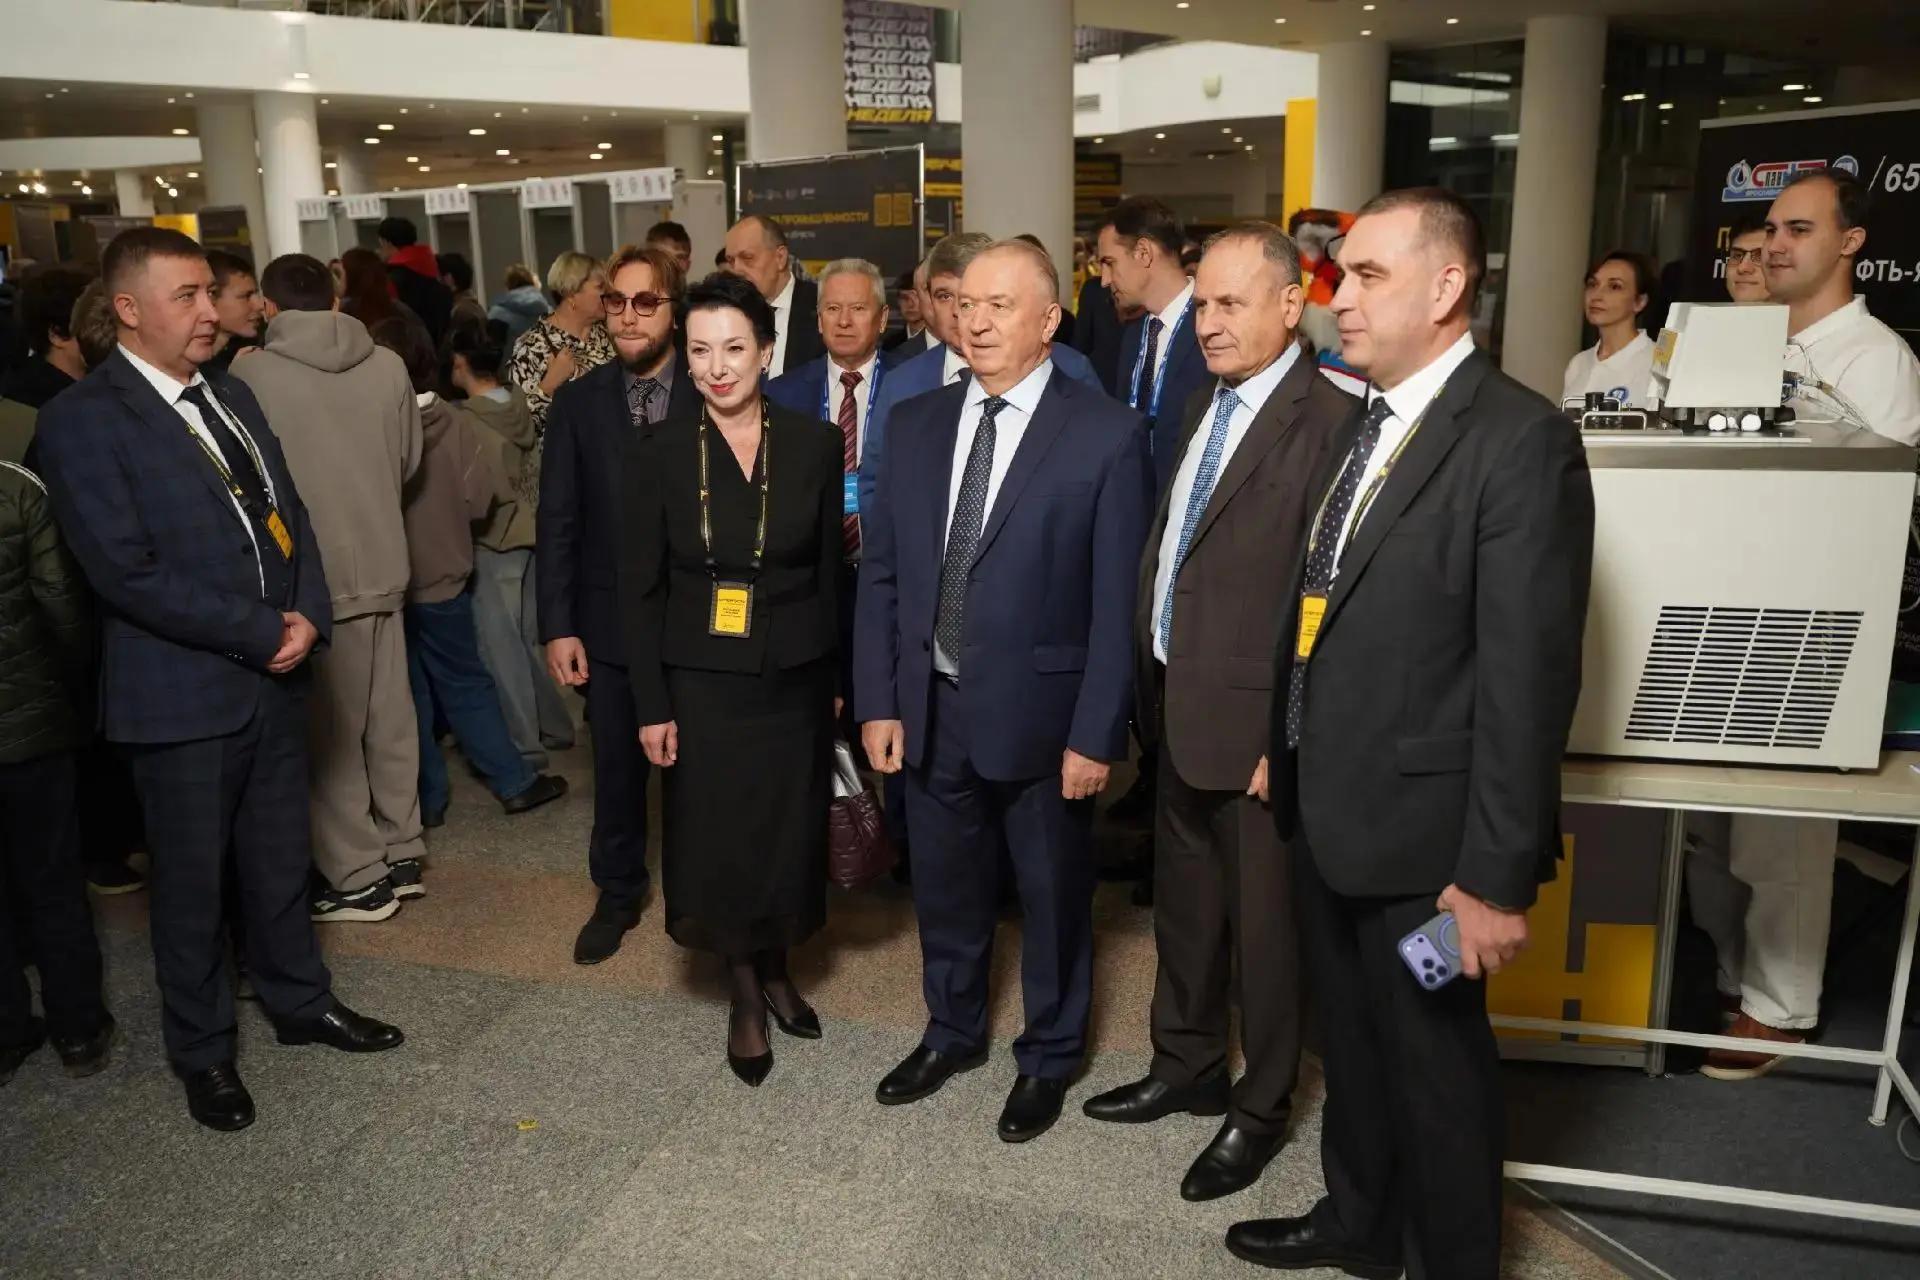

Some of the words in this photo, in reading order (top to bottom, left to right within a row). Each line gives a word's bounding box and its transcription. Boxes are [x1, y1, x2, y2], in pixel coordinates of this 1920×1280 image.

[844, 47, 931, 65] НЕДЕЛЯ
[844, 62, 931, 80] НЕДЕЛЯ
[844, 78, 931, 94] НЕДЕЛЯ
[844, 92, 932, 109] НЕДЕЛЯ
[847, 106, 932, 123] НЕДЕЛЯ
[1884, 163, 1920, 192] 65
